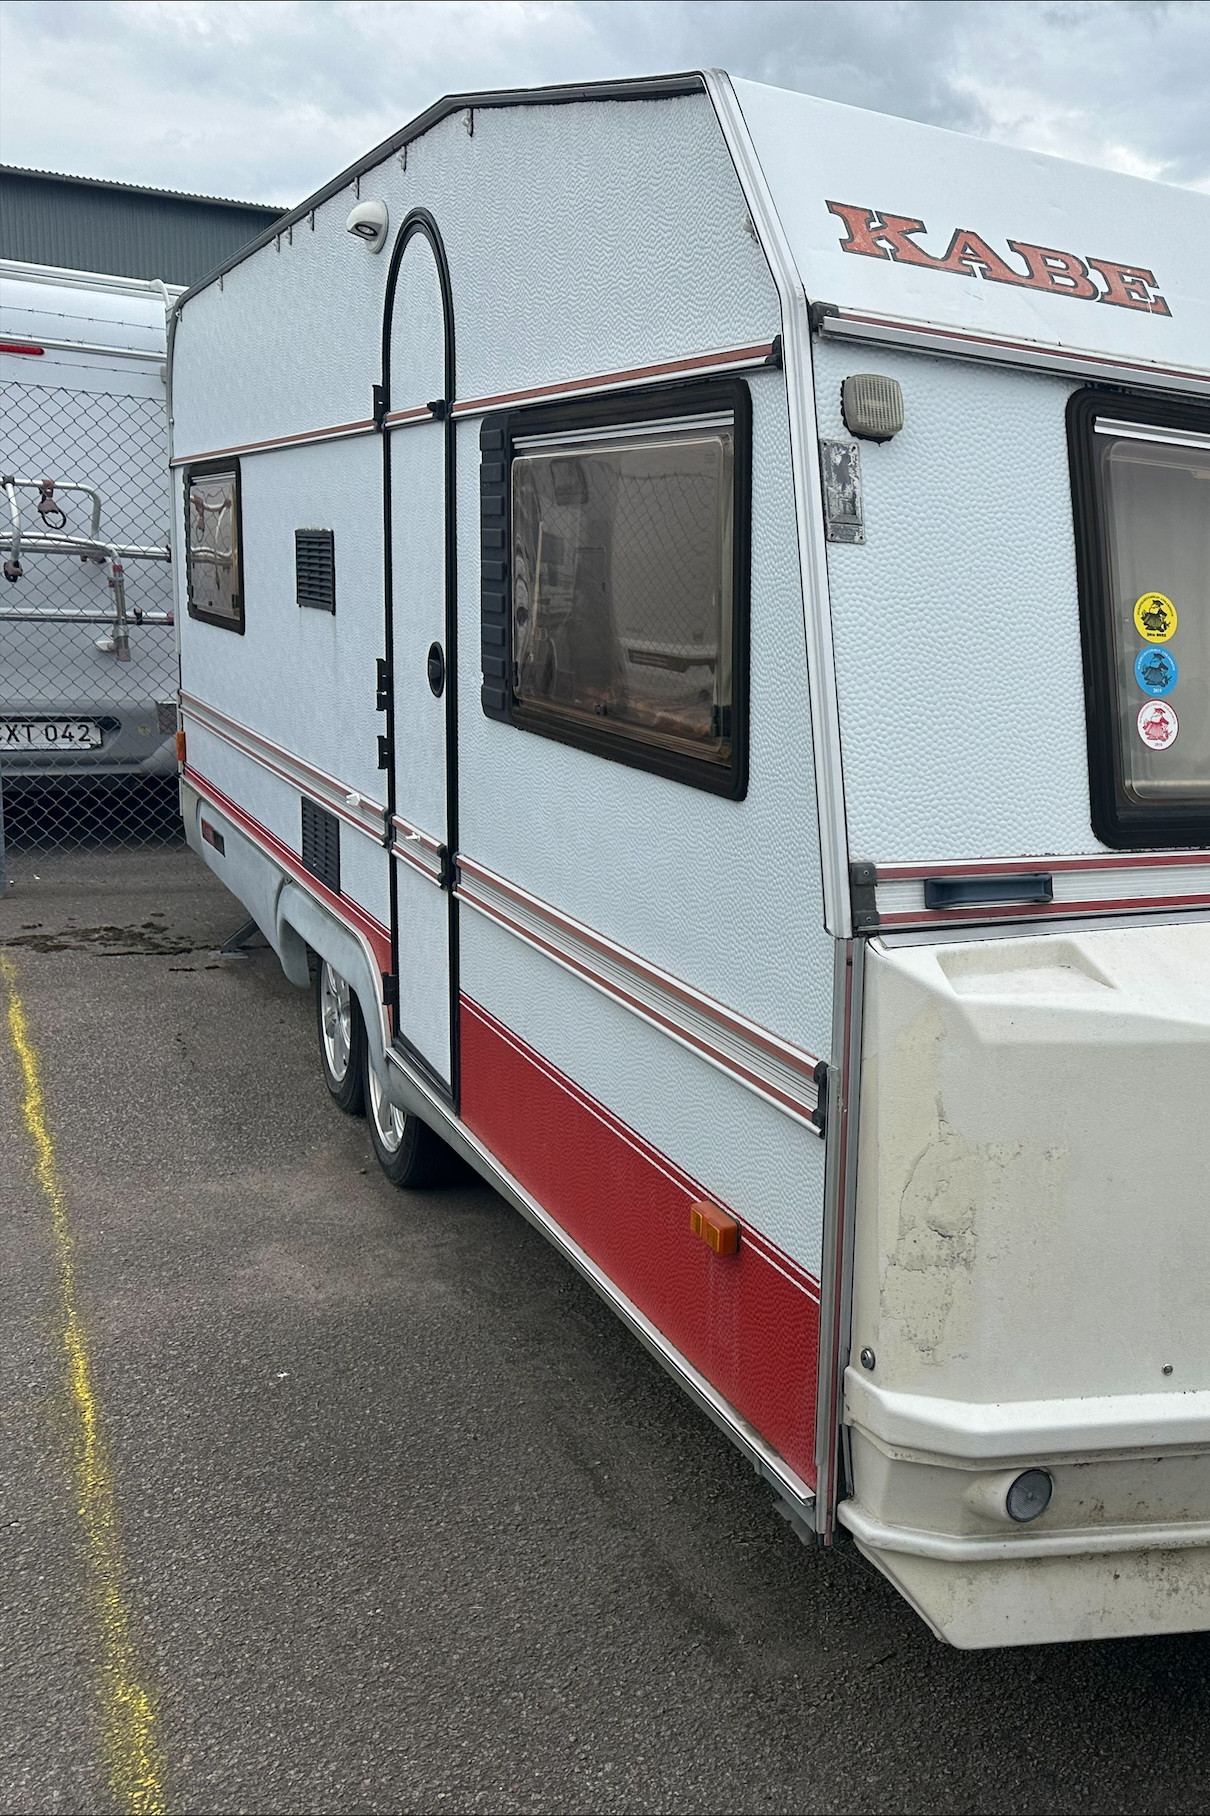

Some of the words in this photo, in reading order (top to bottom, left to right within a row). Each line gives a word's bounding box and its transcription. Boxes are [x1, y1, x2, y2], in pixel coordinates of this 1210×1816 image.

[825, 200, 1173, 318] KABE
[0, 723, 35, 742] XT
[44, 723, 91, 742] 042
